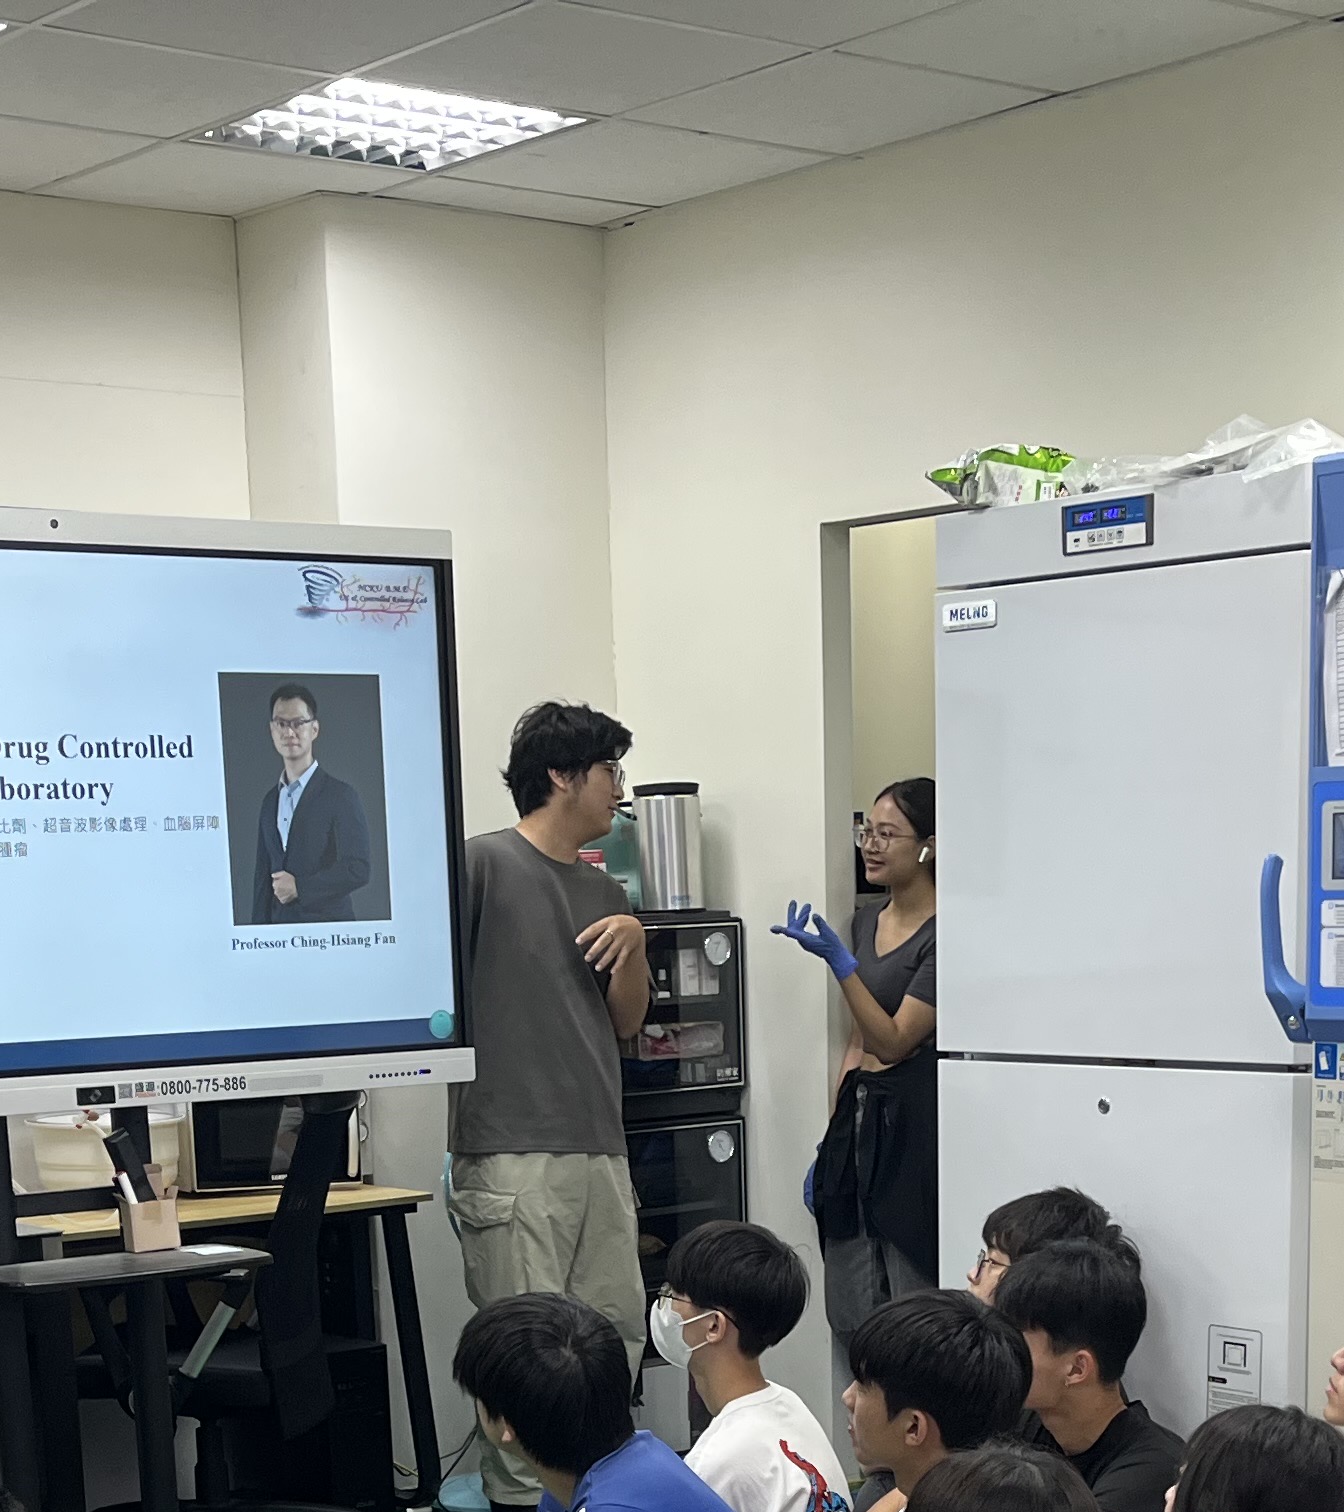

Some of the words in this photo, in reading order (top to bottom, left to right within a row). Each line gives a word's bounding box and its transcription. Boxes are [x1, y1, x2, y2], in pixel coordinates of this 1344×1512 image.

[57, 733, 194, 759] Controlled
[231, 937, 288, 951] Professor
[290, 934, 372, 950] Ching-Hsiang
[374, 932, 397, 945] Fan
